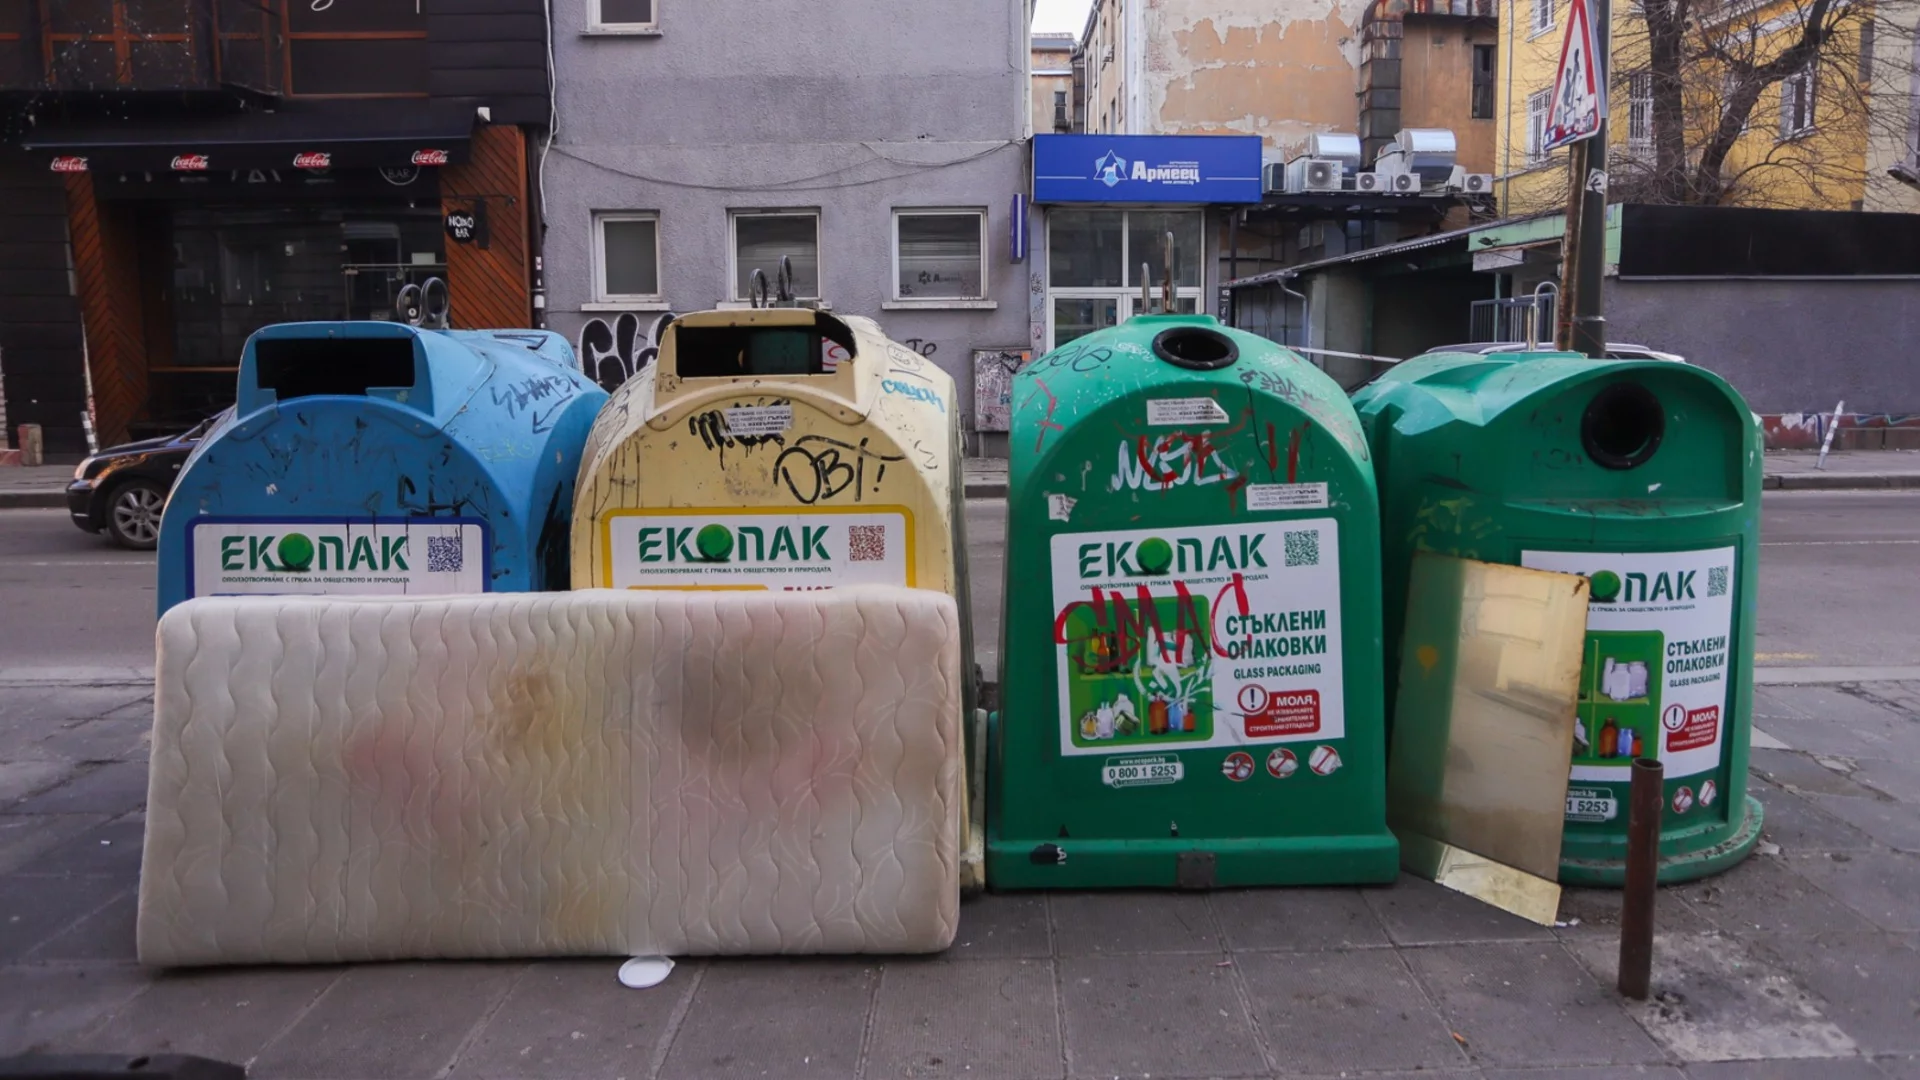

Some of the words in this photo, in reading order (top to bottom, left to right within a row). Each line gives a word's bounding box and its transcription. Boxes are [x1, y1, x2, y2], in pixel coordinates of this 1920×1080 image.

[50, 156, 88, 172] Coca-Cola
[171, 154, 209, 170] Coca-Cola
[293, 153, 332, 168] Coca-Cola
[411, 150, 449, 165] Coca-Cola
[1131, 161, 1200, 183] Армеец
[638, 524, 831, 563] ЕКОПАК
[221, 533, 410, 572] ЕКОПАК
[1078, 533, 1268, 579] ЕКОПАК
[795, 566, 832, 574] ПРИРОДАТА
[1561, 570, 1697, 603] ОПАК
[1226, 610, 1326, 636] СТЪКЛЕНИ
[1227, 635, 1327, 660] ОПАКОВКИ
[1667, 635, 1726, 656] СТЪКЛЕНИ
[1233, 667, 1265, 679] GLASS
[1266, 663, 1321, 677] PACKAGING
[1666, 653, 1725, 674] ОПАКОВКИ
[1669, 677, 1690, 688] GLASS
[1690, 673, 1721, 686] PACKAGING
[1276, 694, 1317, 707] МОЛЯ,
[1108, 768, 1116, 779] 0
[1118, 767, 1138, 778] 800
[1142, 766, 1147, 777] 1
[1150, 765, 1177, 777] 5253
[1567, 800, 1573, 811] 1
[1577, 800, 1609, 813] 5253
